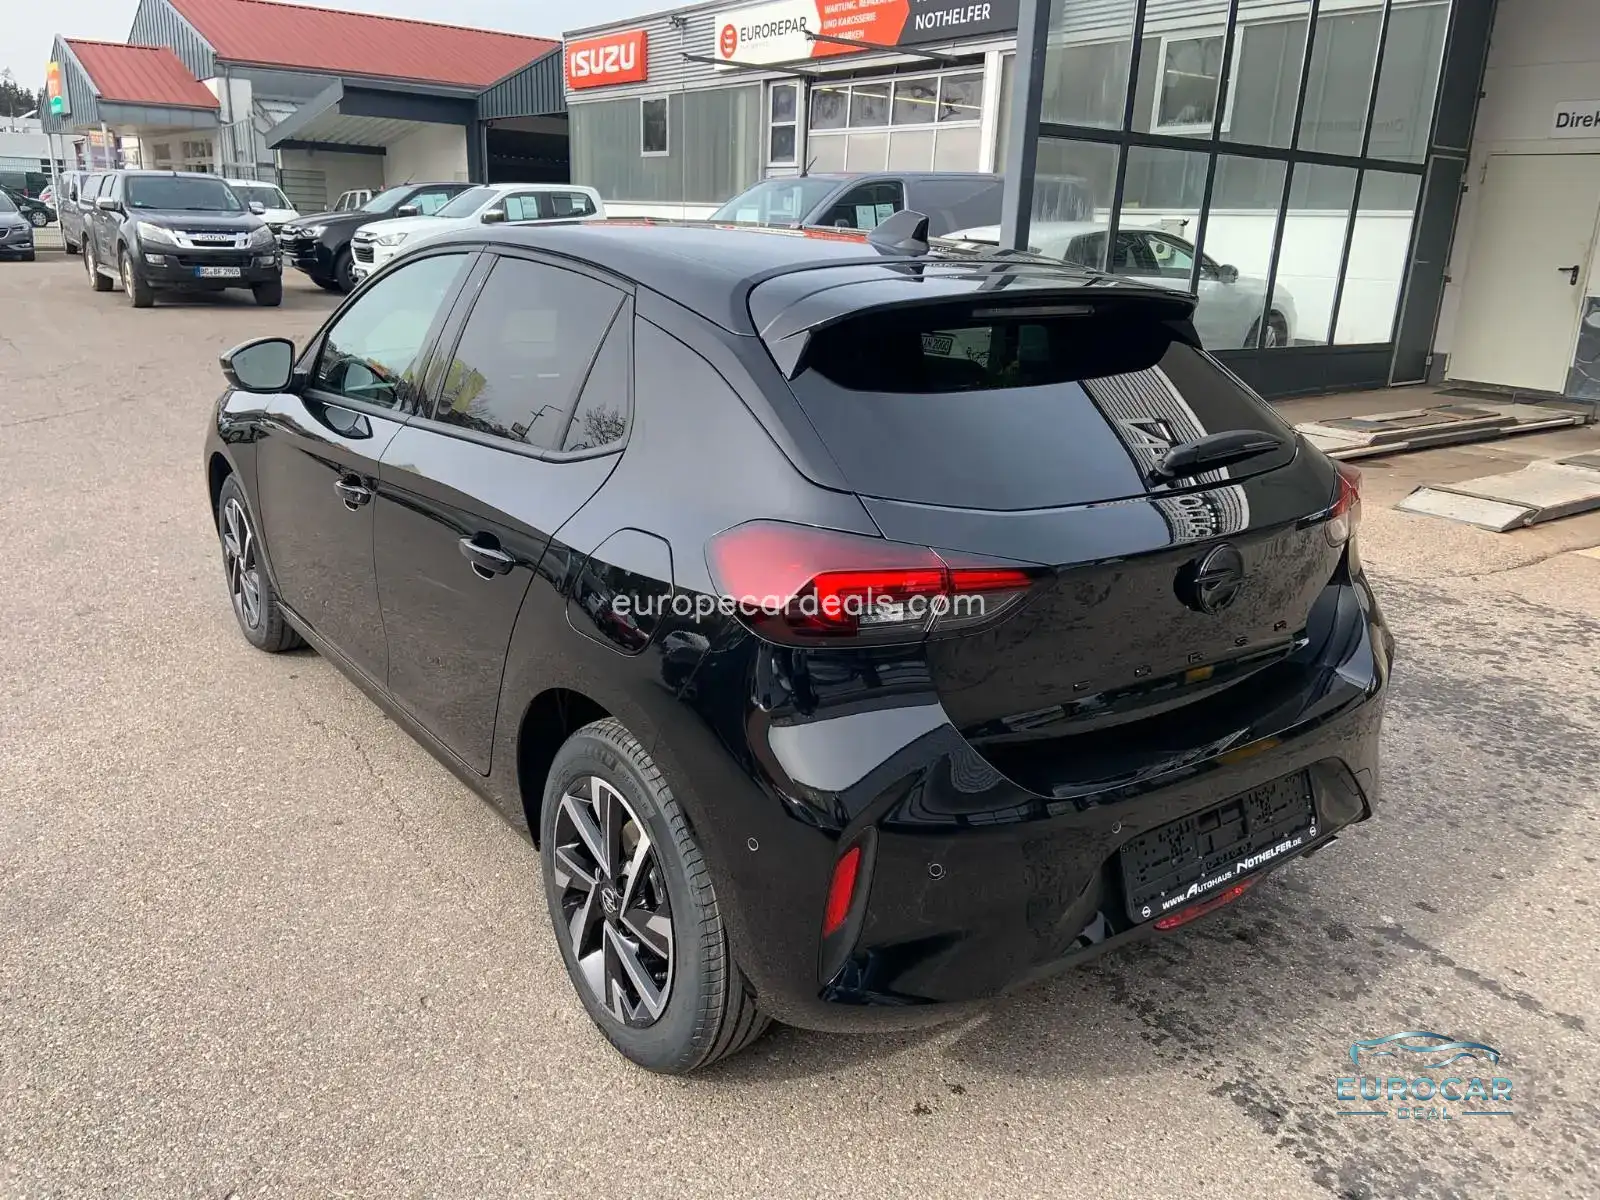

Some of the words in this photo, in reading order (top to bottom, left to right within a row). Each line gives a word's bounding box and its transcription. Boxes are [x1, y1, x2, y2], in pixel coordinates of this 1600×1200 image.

[740, 16, 807, 42] EUROREPAR
[823, 18, 837, 29] UND
[838, 12, 877, 26] KAROSSERIE
[915, 3, 991, 30] NOTHELFER
[570, 41, 636, 78] ISUZU
